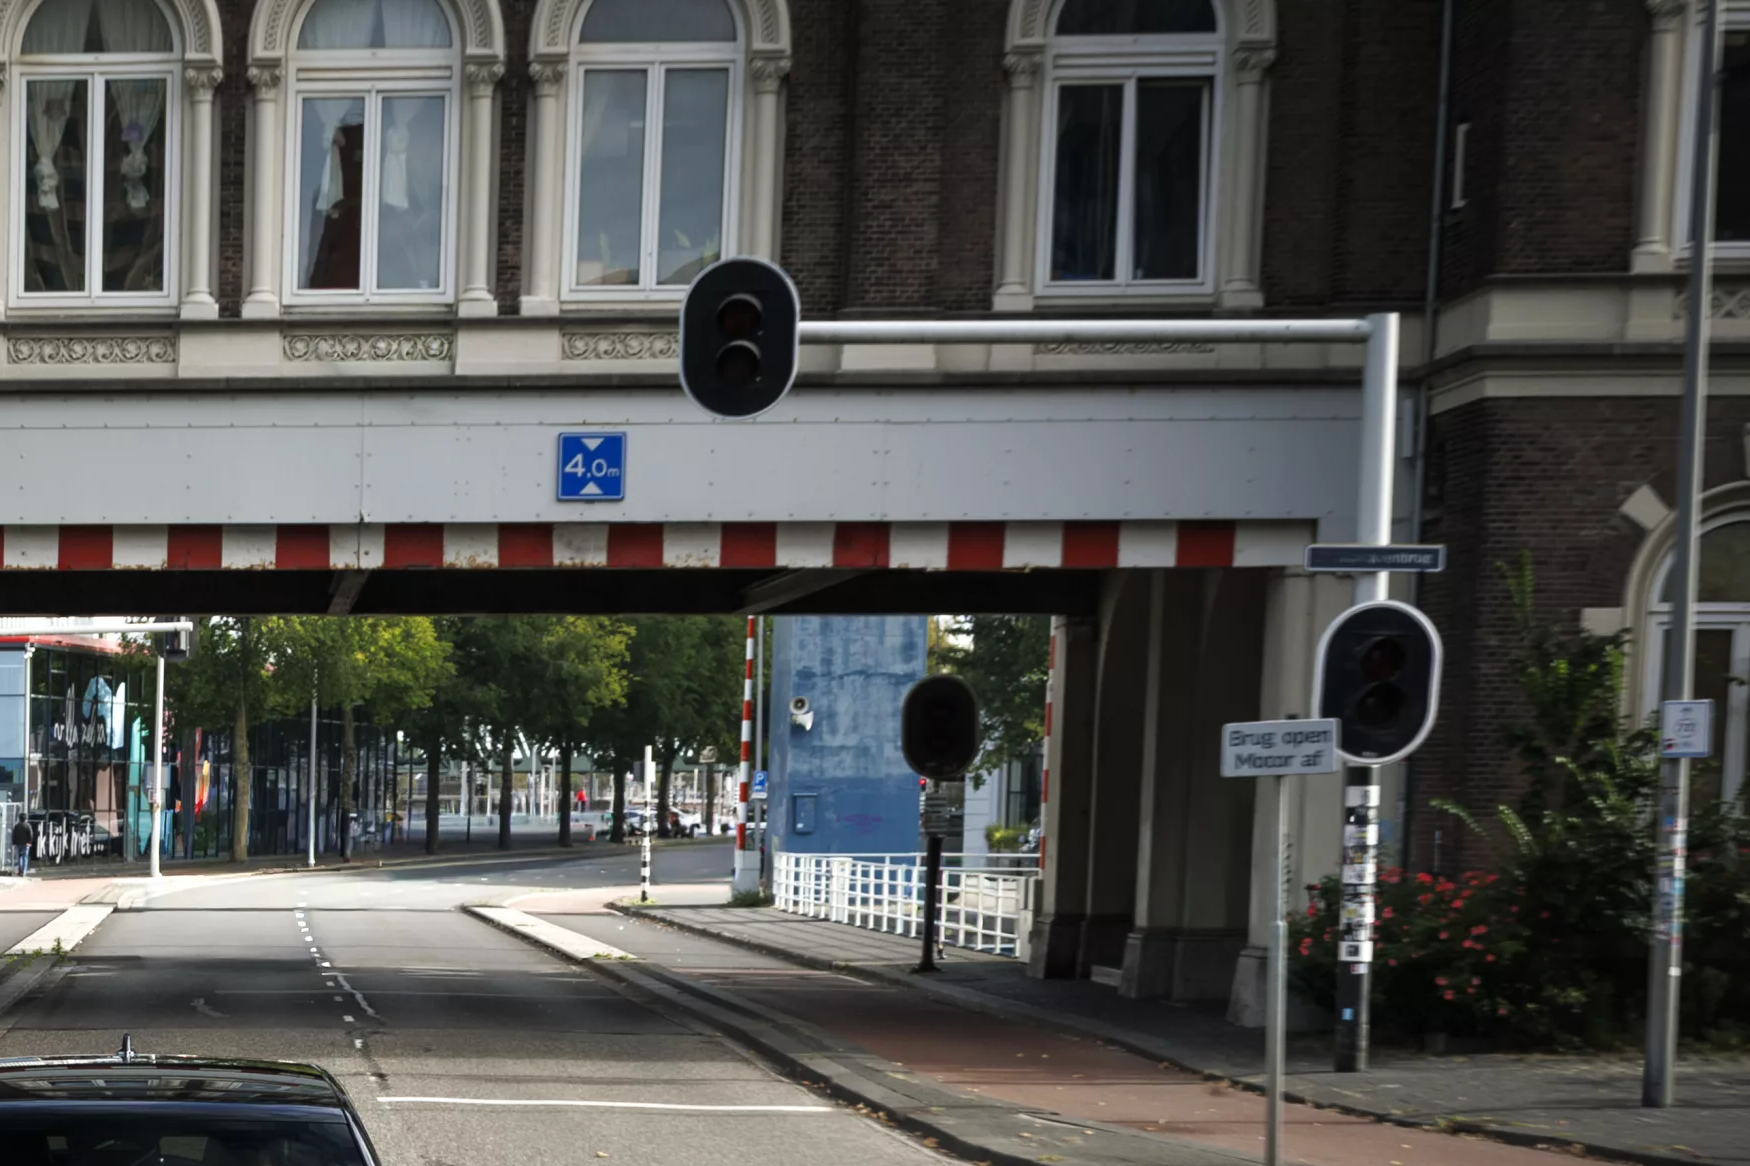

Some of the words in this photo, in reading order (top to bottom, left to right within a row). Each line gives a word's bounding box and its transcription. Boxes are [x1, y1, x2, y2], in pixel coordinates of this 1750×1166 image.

[1229, 730, 1276, 749] Brug
[1280, 730, 1333, 748] open
[1234, 753, 1295, 769] Motor
[1300, 749, 1325, 767] af
